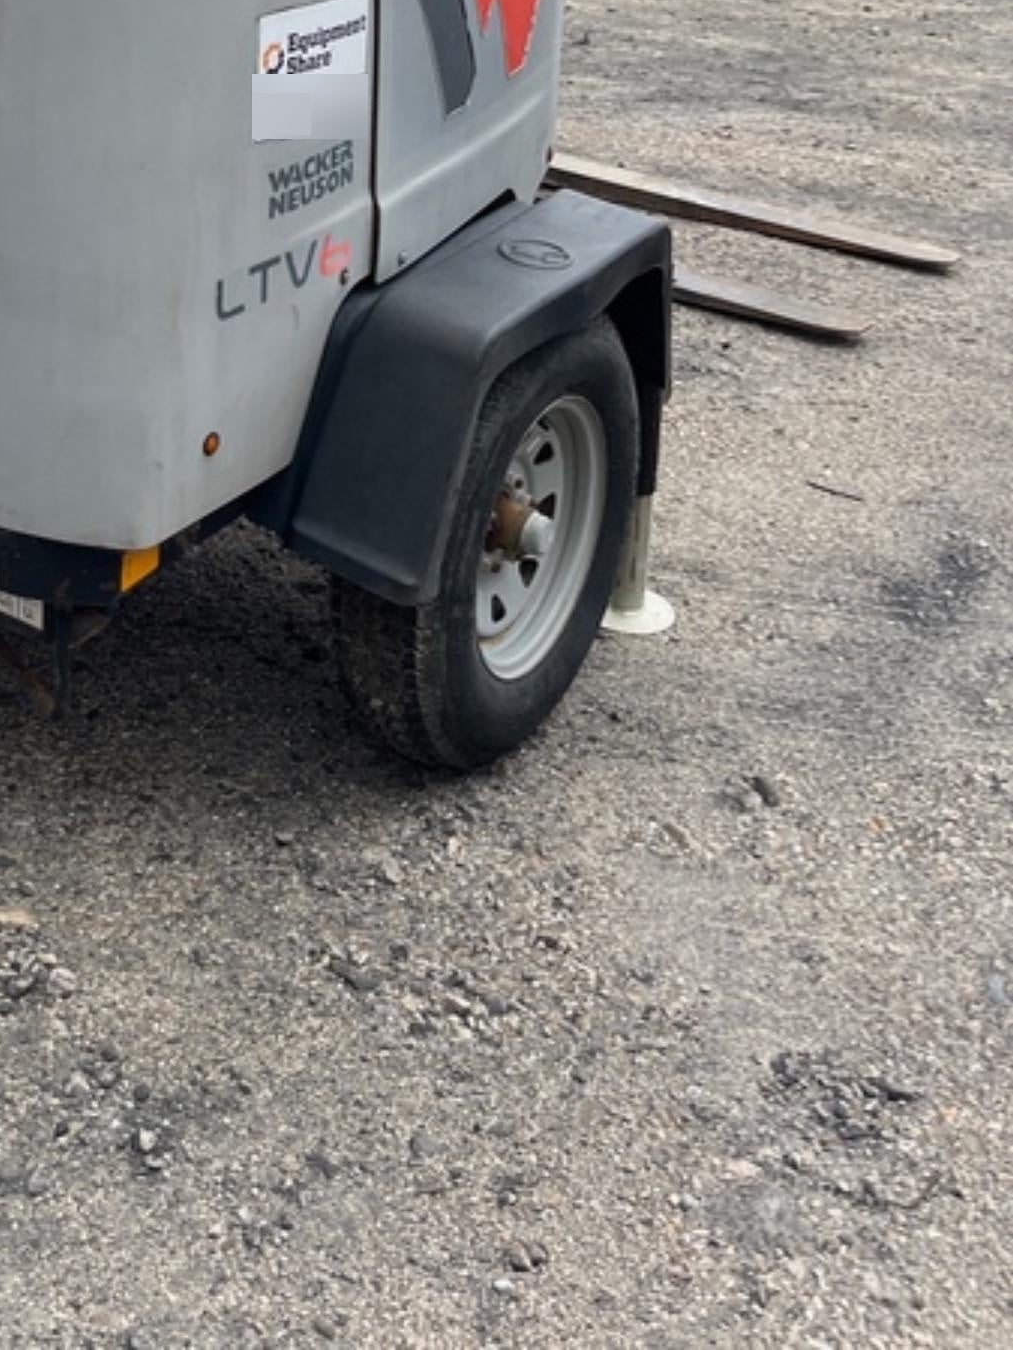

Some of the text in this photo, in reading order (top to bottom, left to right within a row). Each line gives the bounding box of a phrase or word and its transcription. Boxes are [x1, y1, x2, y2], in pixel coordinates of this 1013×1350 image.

[287, 15, 366, 53] Equipment
[287, 51, 332, 74] Share
[268, 140, 354, 192] WACKER
[268, 161, 354, 219] NEUSON
